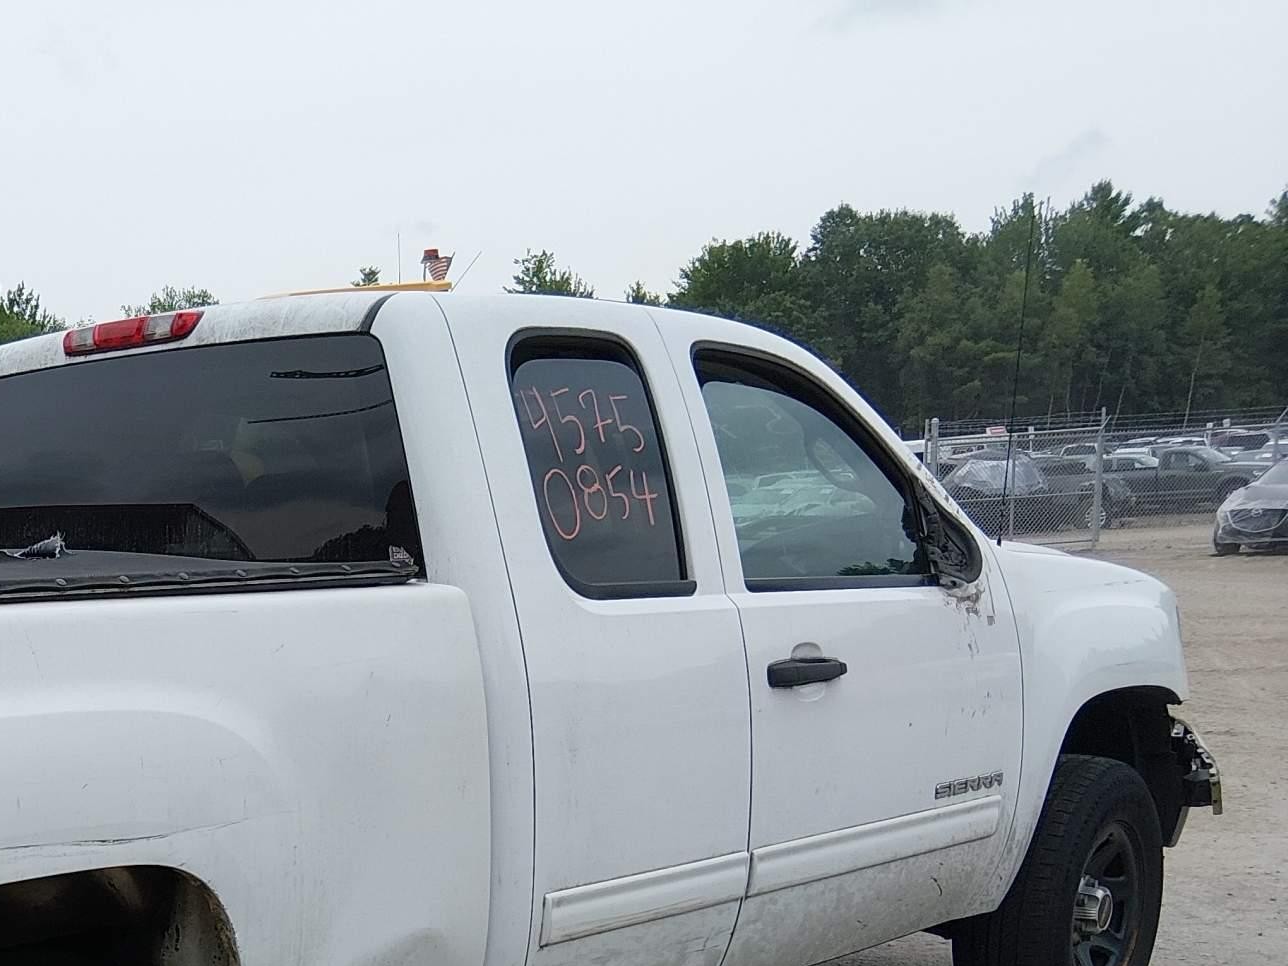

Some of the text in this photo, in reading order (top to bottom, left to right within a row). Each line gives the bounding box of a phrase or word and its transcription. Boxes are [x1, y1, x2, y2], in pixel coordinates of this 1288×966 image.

[518, 386, 645, 463] 4575
[543, 465, 658, 540] 0854
[934, 769, 1004, 801] SIERRA
